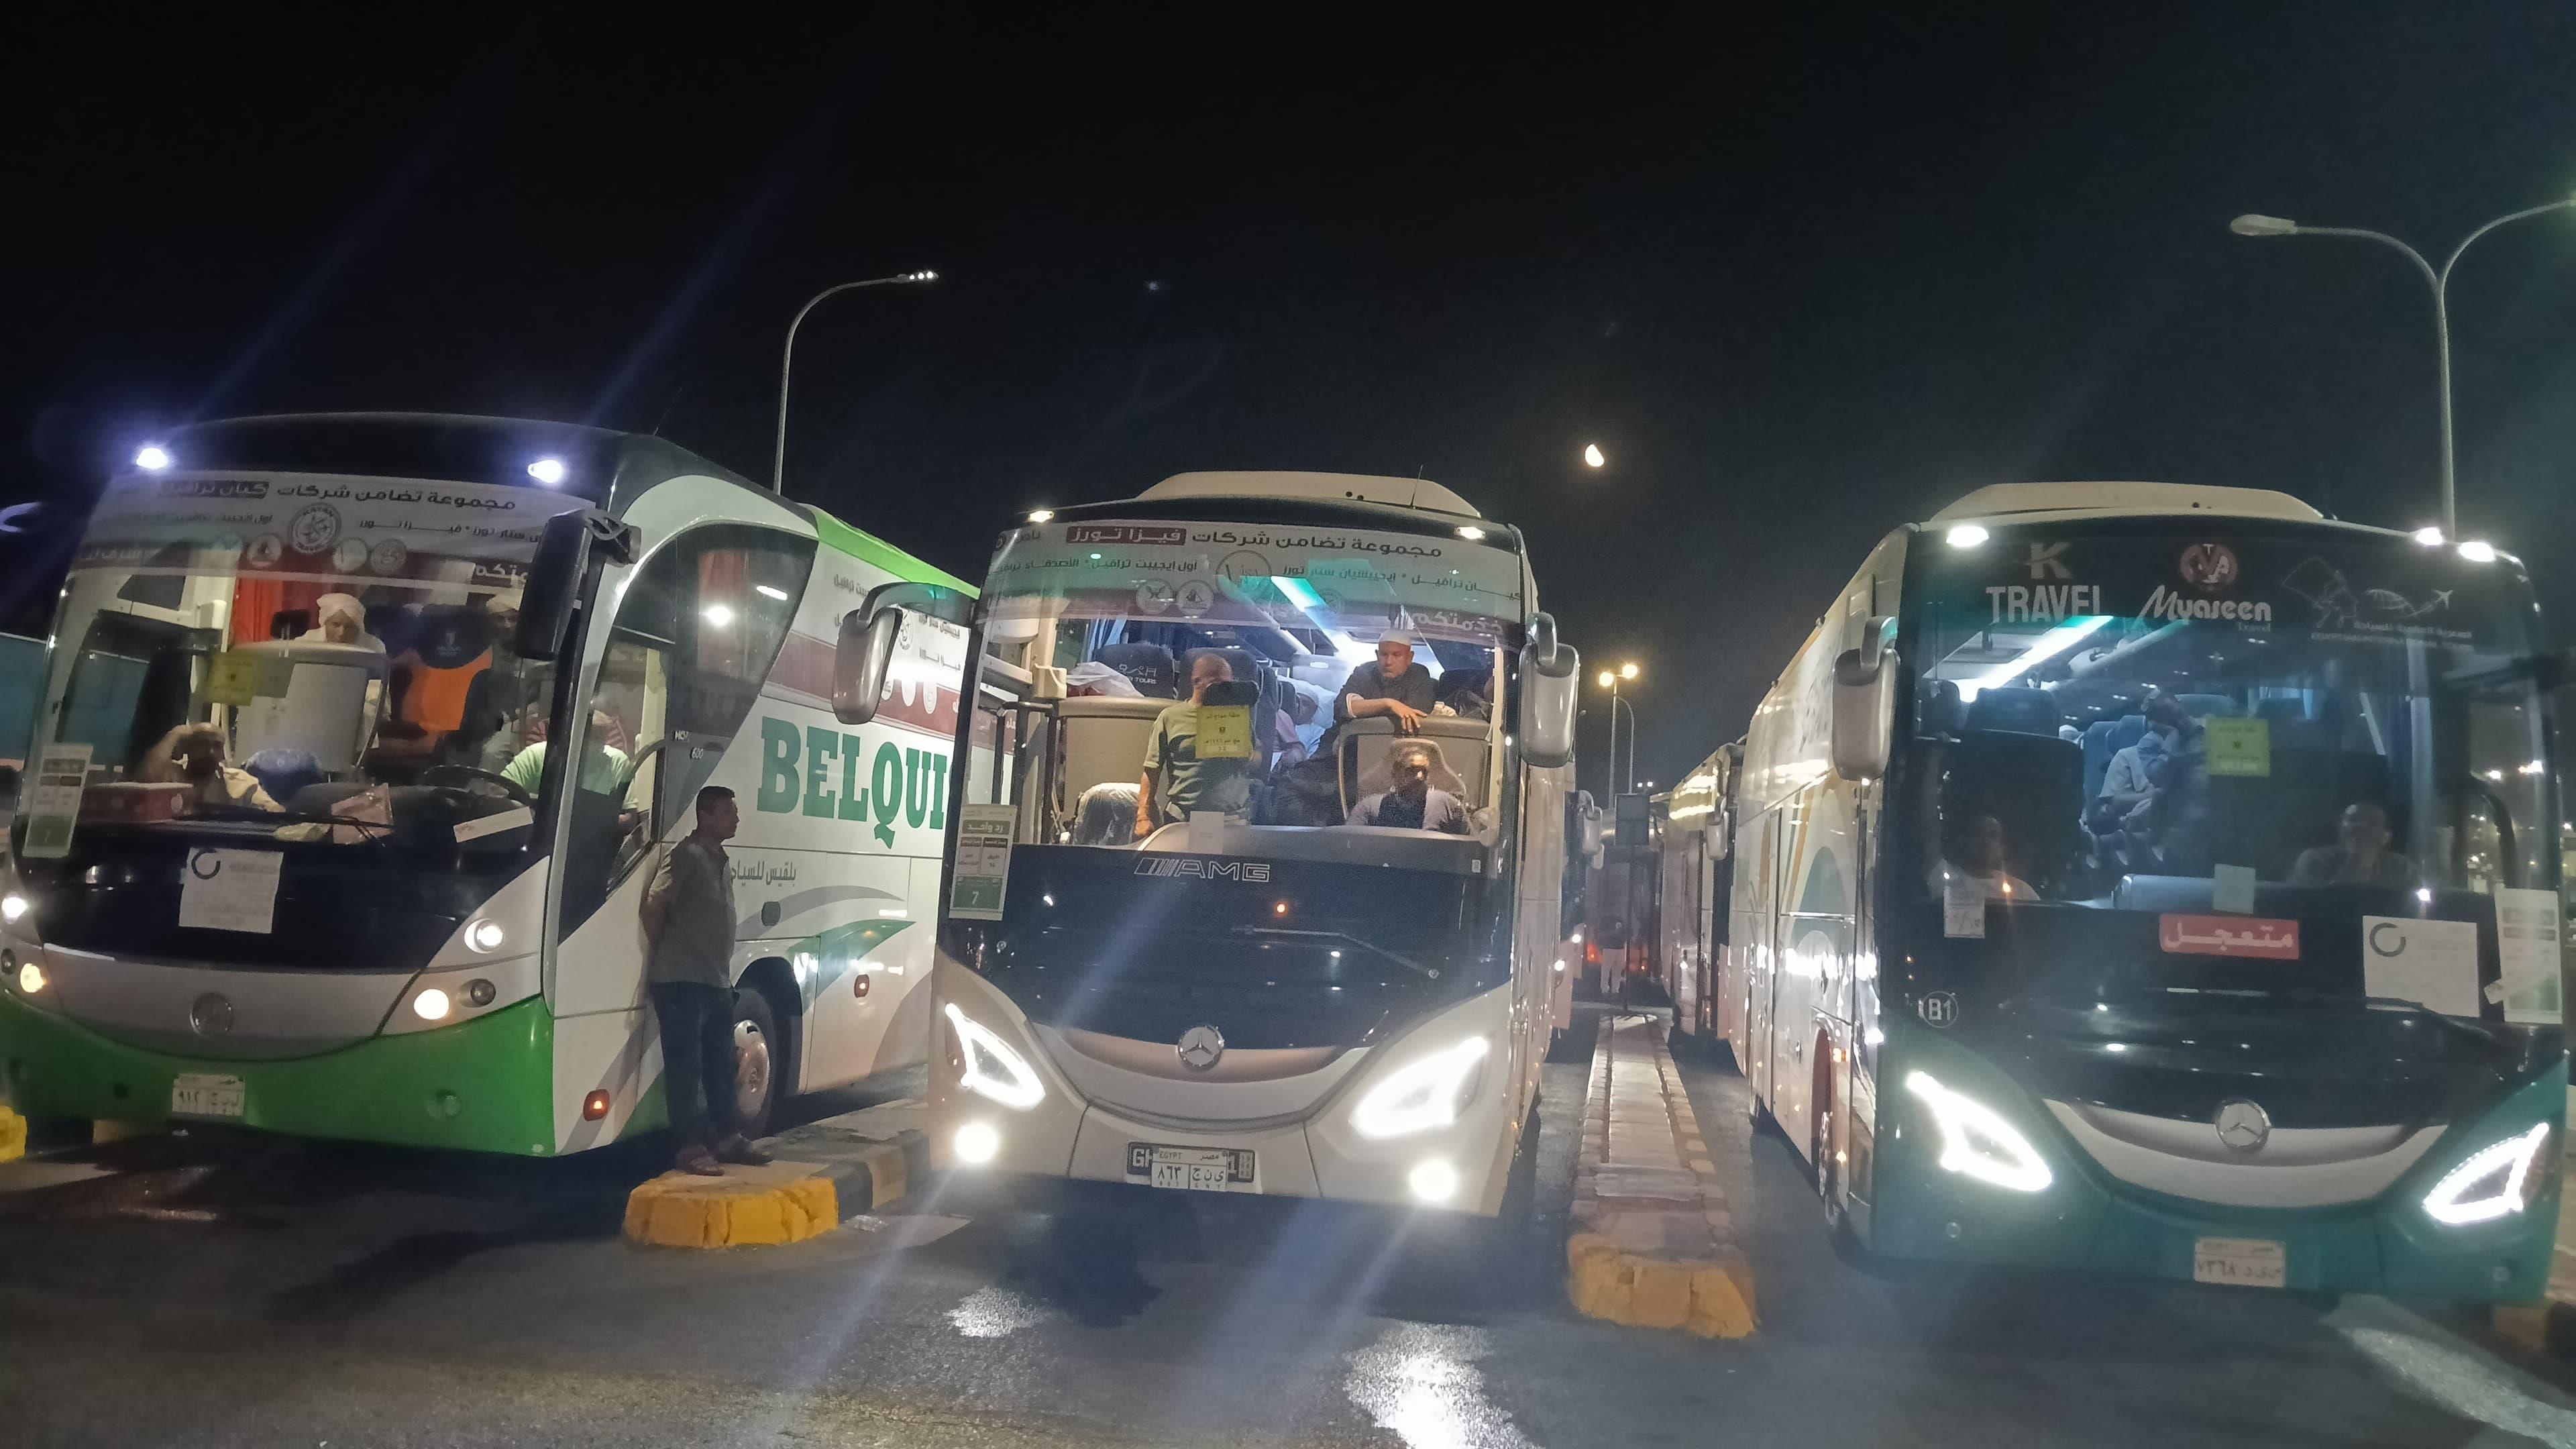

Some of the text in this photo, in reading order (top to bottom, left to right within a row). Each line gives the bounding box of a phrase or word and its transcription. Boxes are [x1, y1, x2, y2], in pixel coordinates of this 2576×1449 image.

[219, 481, 268, 496] كيان
[277, 484, 351, 499] شركات
[355, 488, 423, 502] تضامن
[427, 492, 515, 510] مجموعة
[1072, 527, 1123, 542] تورز
[1128, 527, 1181, 543] فيزا
[1191, 531, 1270, 547] شركات
[1276, 535, 1346, 549] تضامن
[1351, 538, 1442, 557] مجموعة
[1282, 565, 1305, 576] تورز
[1411, 574, 1464, 588] ترافيل
[1411, 611, 1503, 635] خدمتكم
[757, 716, 949, 849] BELQUI
[731, 859, 798, 888] بلقيس للسياح
[1174, 859, 1271, 883] AMG
[972, 890, 980, 906] 7
[2164, 921, 2294, 952] متعجل
[1159, 1150, 1183, 1159] EGYPT
[1199, 1153, 1219, 1161] مصر
[1158, 1165, 1182, 1180] ٨٦٣
